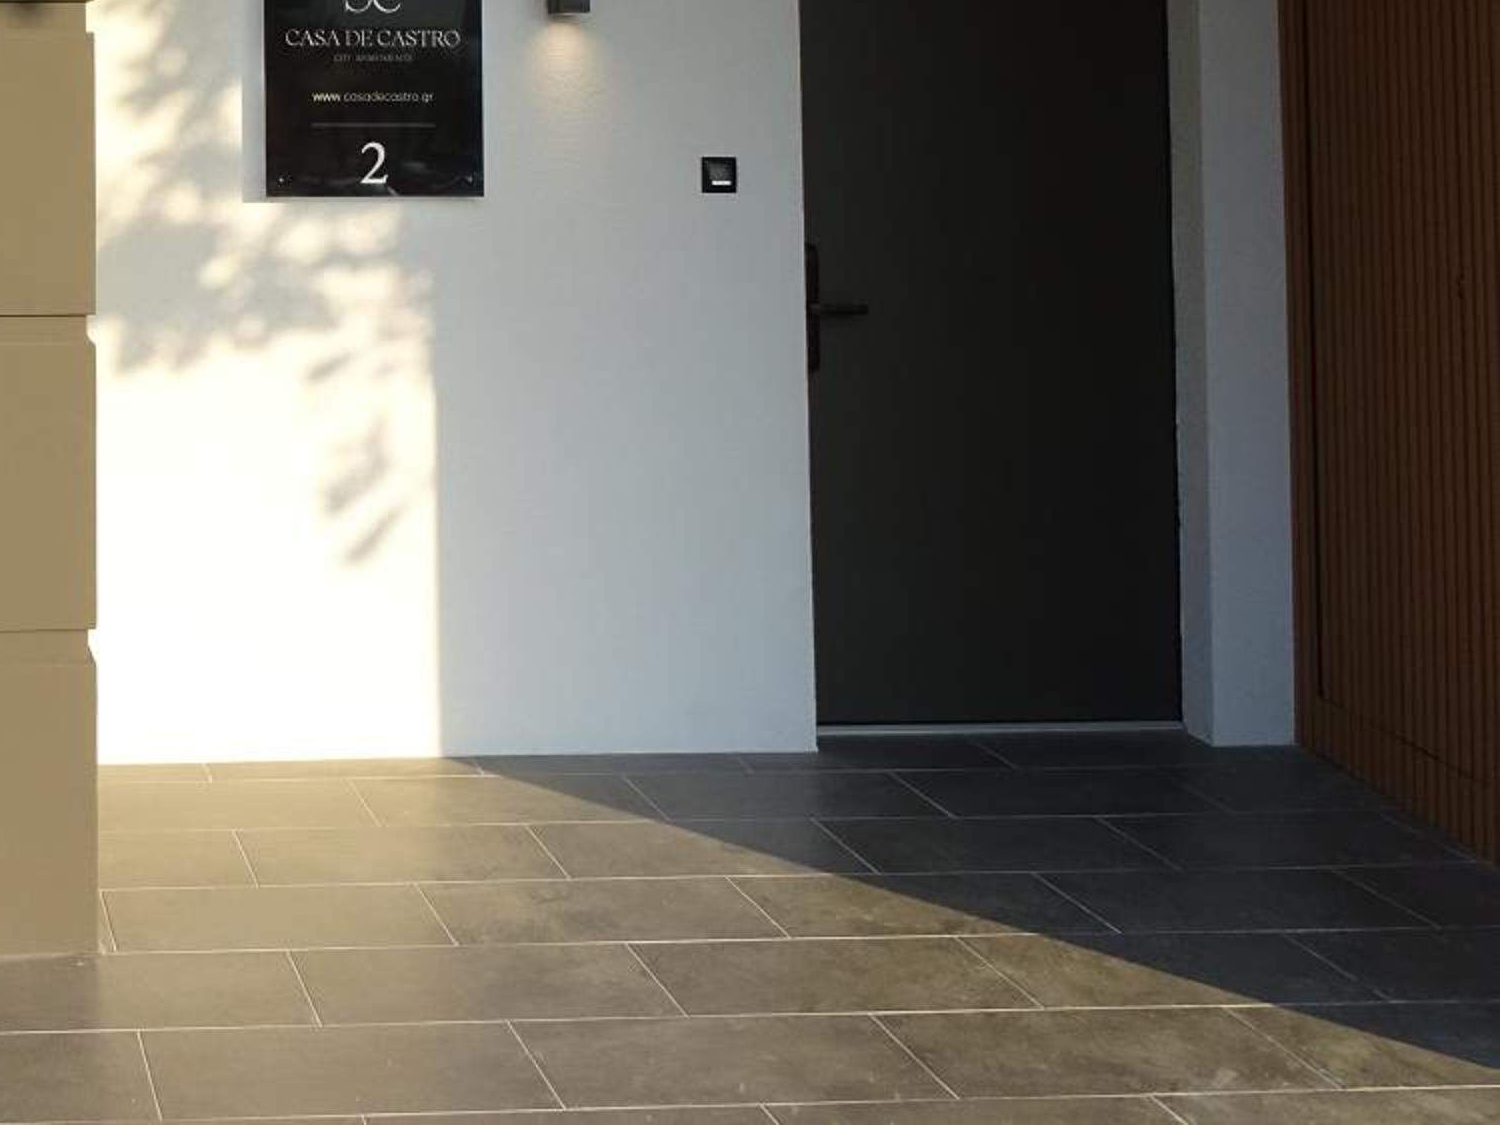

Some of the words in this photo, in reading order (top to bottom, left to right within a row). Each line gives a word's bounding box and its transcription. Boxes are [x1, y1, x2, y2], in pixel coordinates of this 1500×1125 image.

[285, 29, 340, 47] CASA
[345, 29, 373, 47] DE
[376, 29, 462, 48] CASTRO
[359, 141, 389, 185] 2
